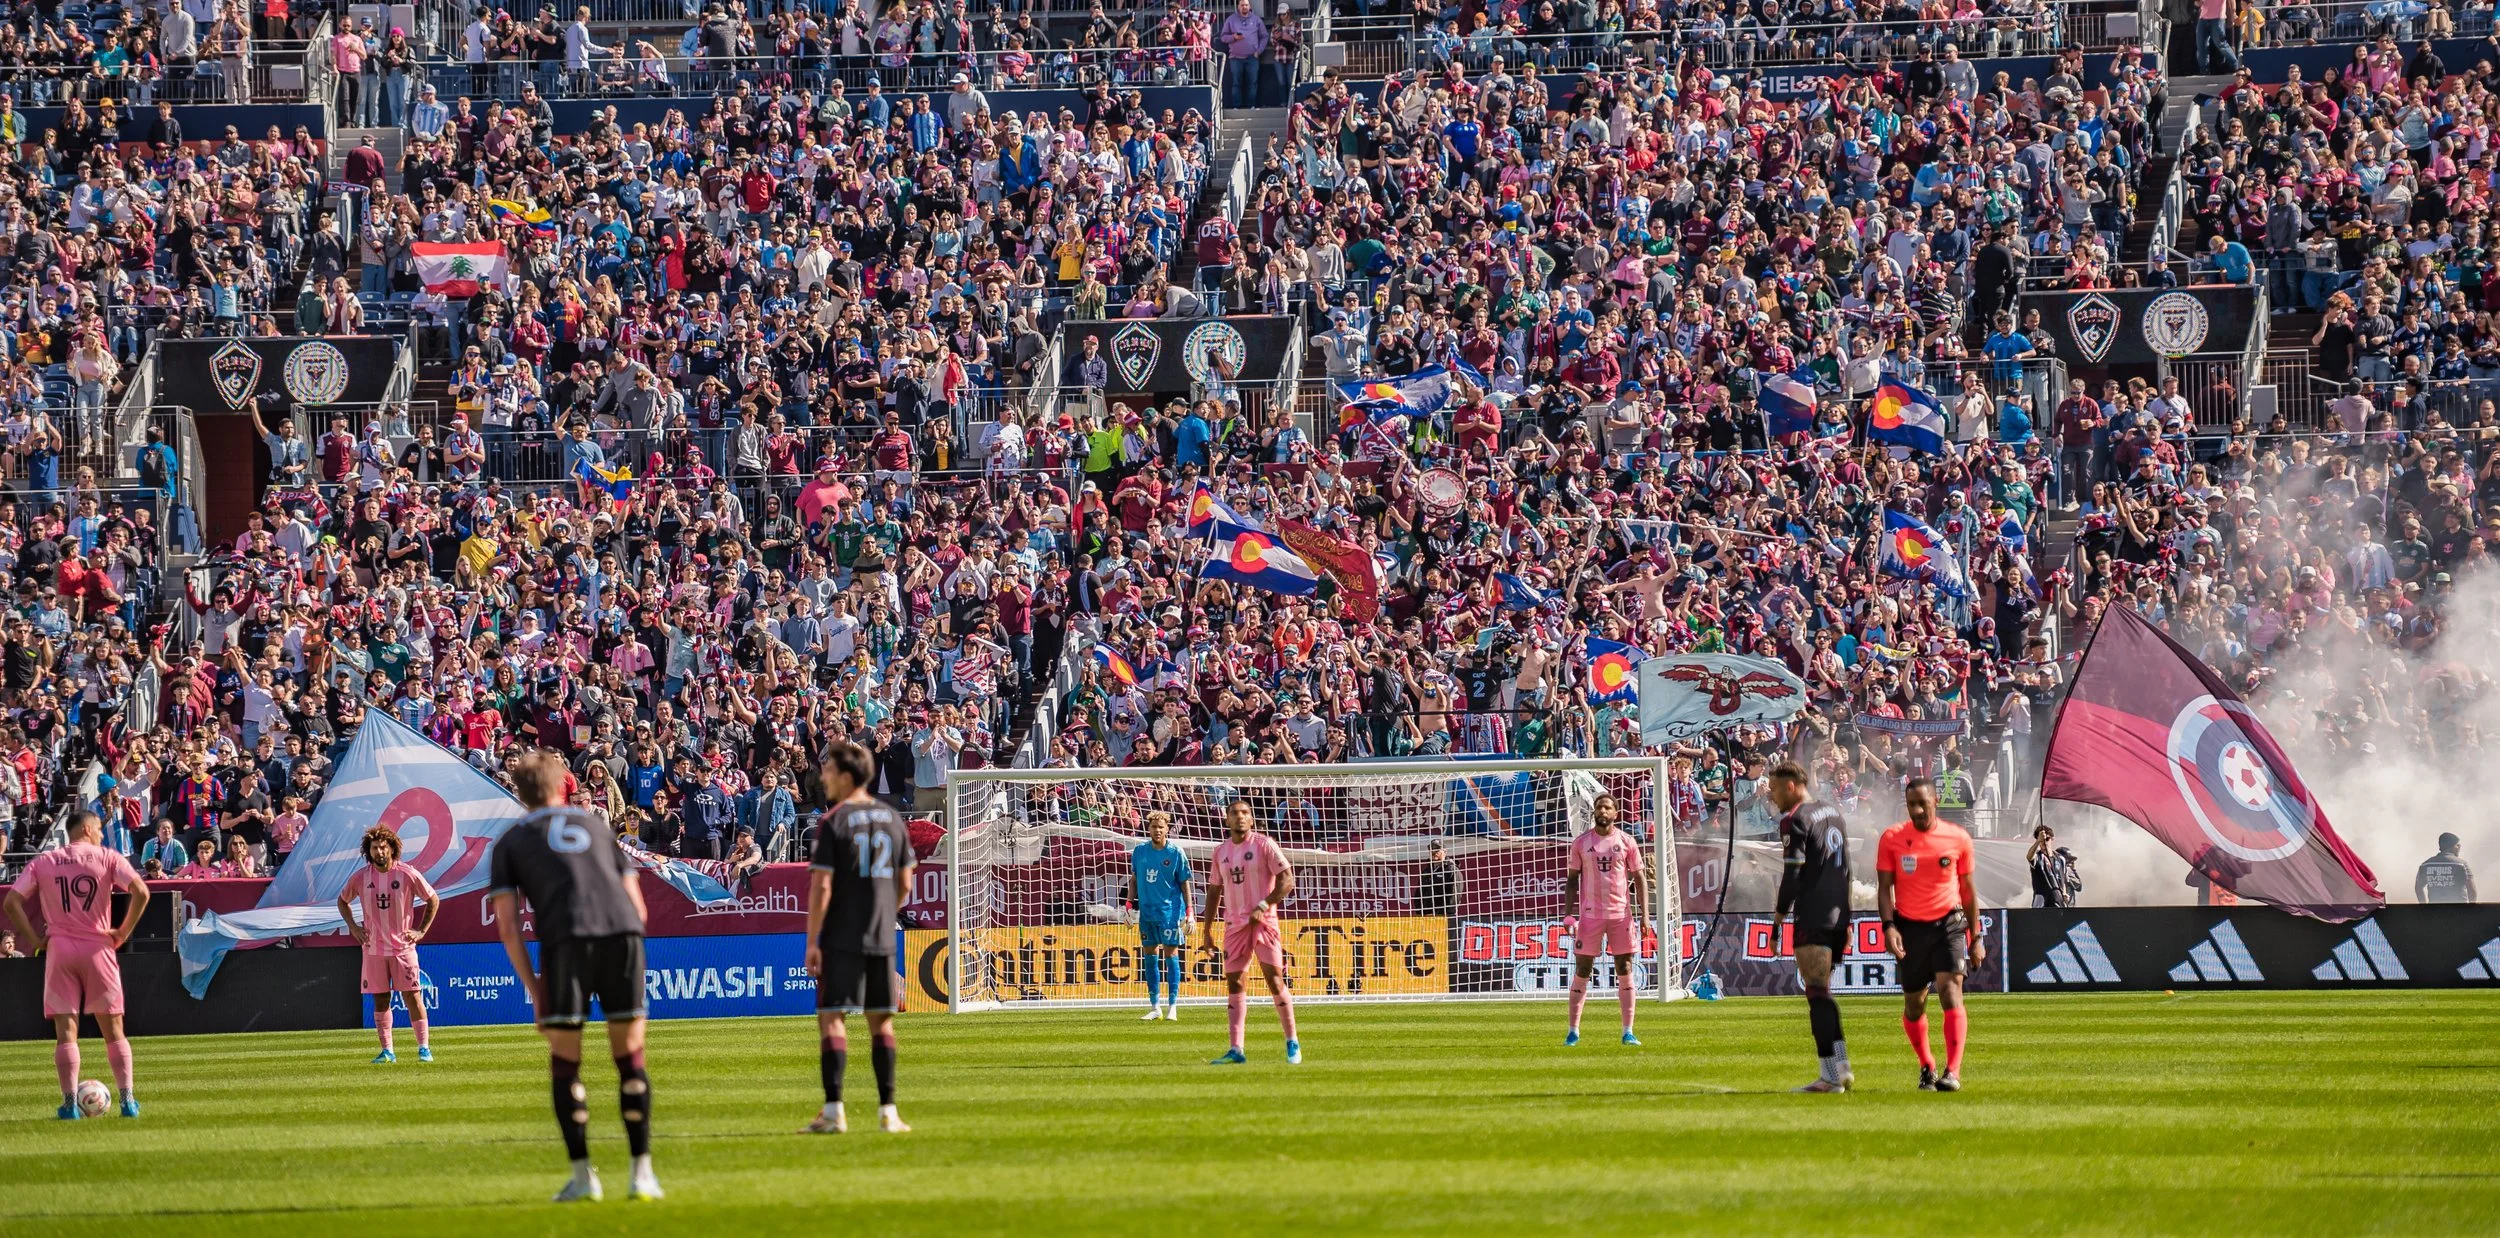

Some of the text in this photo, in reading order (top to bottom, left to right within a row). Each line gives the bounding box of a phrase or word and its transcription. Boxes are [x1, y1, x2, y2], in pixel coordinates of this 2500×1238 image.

[1201, 223, 1222, 238] 05
[1473, 680, 1486, 698] 2
[1857, 714, 1960, 732] COLORADO VS EVERYBODY
[640, 778, 651, 788] 10
[547, 814, 592, 854] 6
[853, 830, 894, 879] 12
[1825, 824, 1844, 868] 9
[2426, 866, 2453, 876] argus
[1285, 866, 1410, 907] OLORADO
[1497, 869, 1569, 896] uchea
[55, 874, 98, 914] 19
[696, 886, 798, 914] ealth
[1310, 901, 1385, 912] RAPIDS
[1163, 928, 1181, 941] 97
[1463, 923, 1698, 961] DISCNT
[788, 966, 808, 977] DIS
[918, 925, 1436, 1005] Cntinenta Tire
[450, 976, 515, 988] PLATINUM
[465, 989, 499, 1000] PLUS
